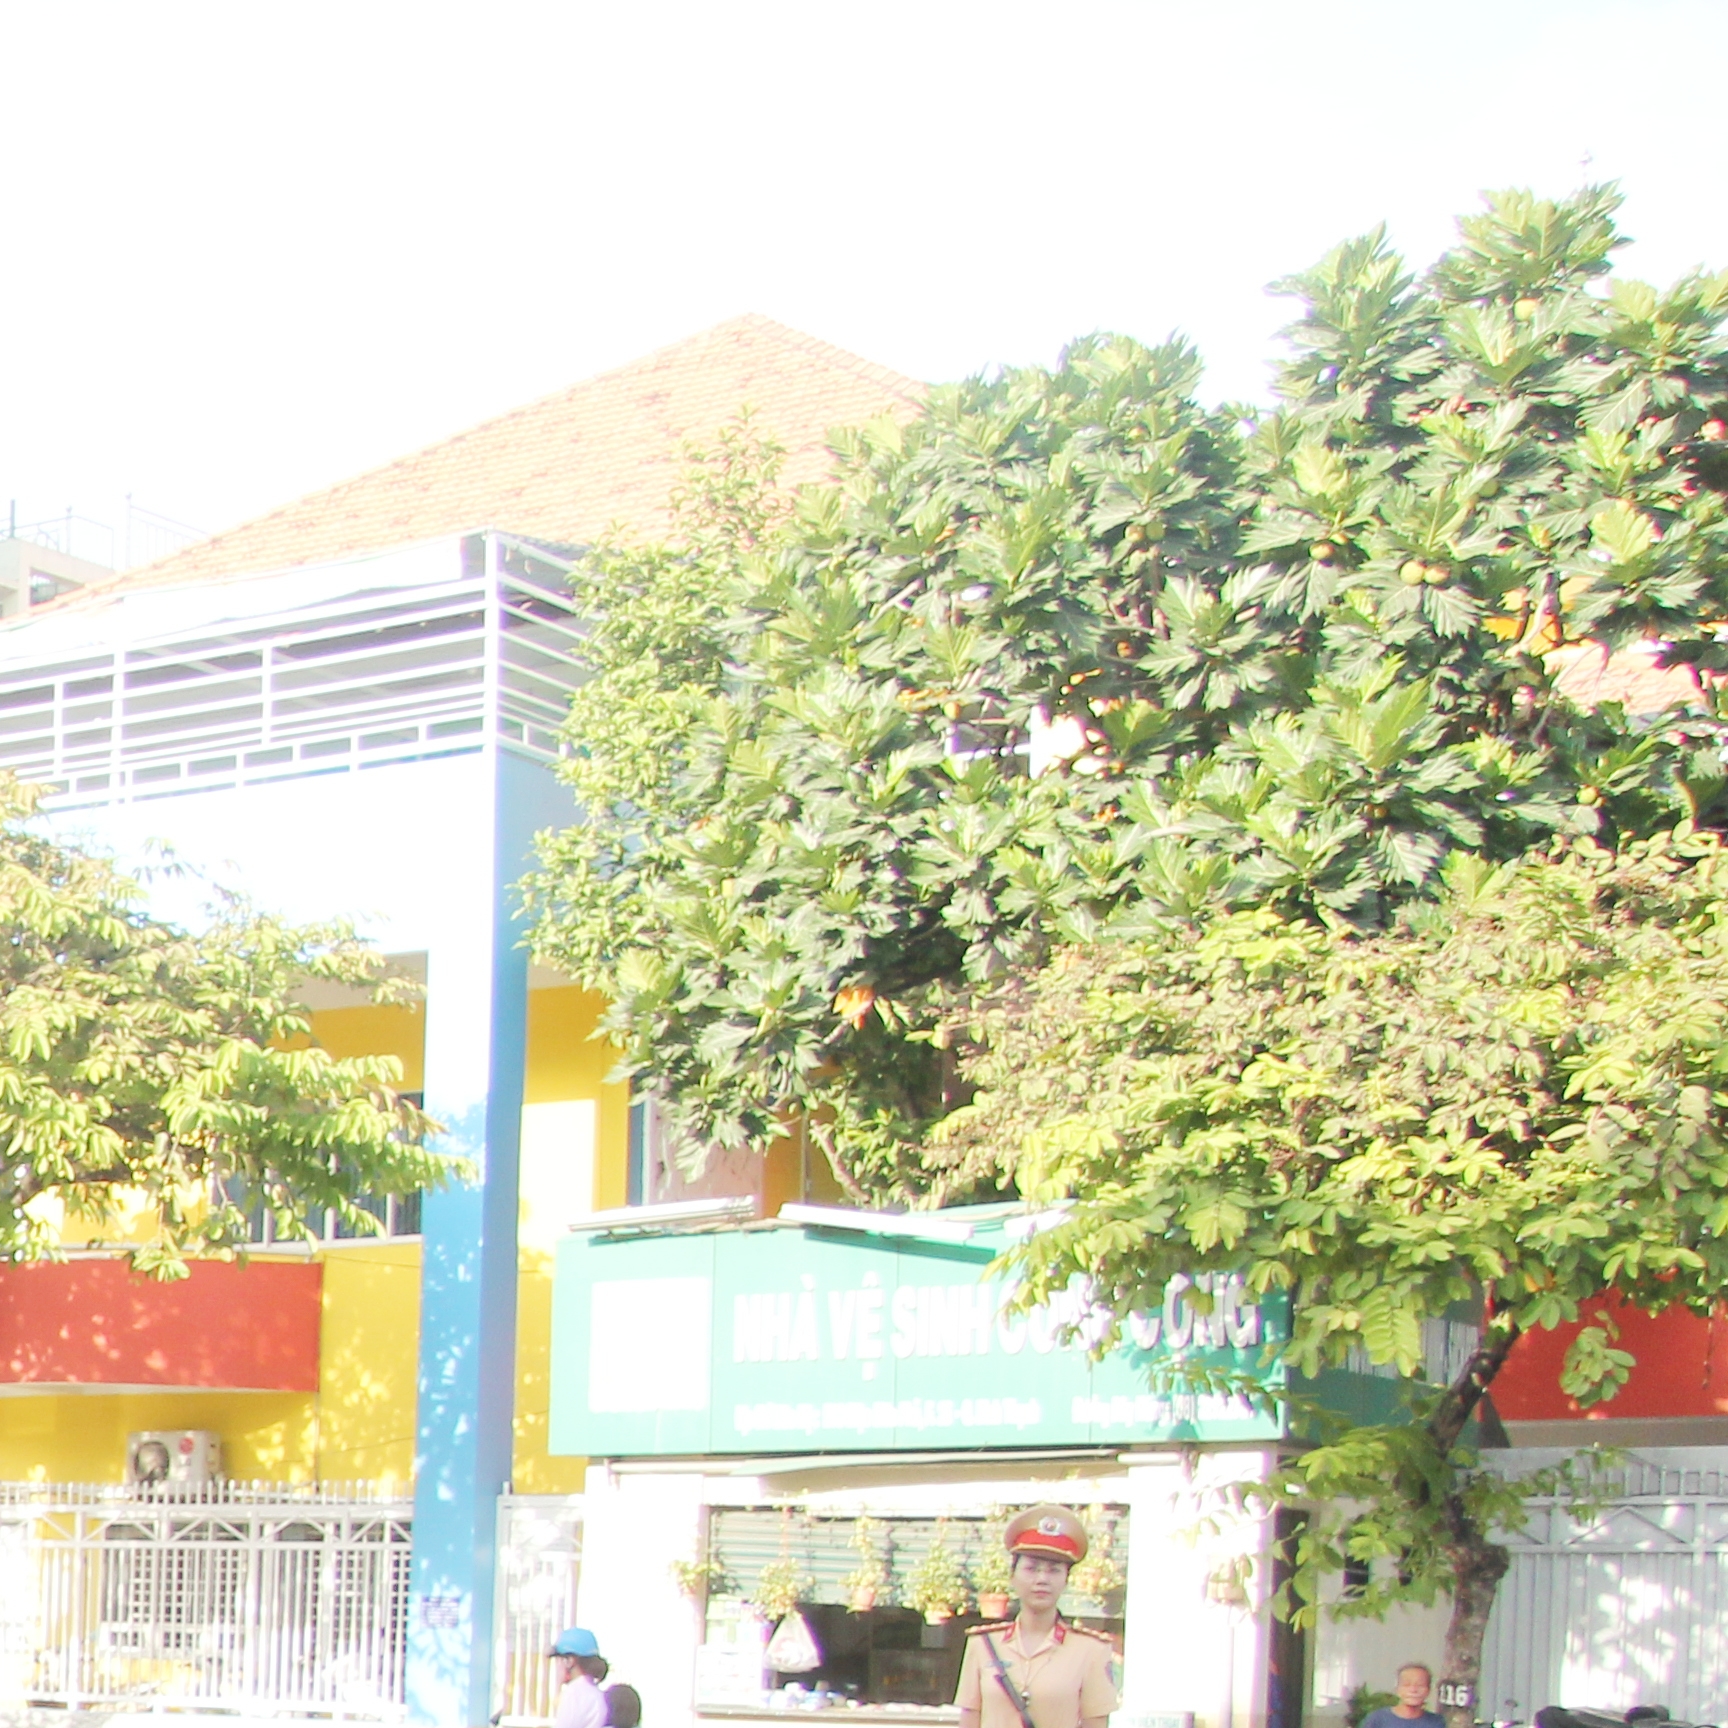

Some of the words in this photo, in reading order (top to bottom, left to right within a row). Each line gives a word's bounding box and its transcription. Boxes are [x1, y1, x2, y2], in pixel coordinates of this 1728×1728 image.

[732, 1274, 820, 1365] NHÀ
[827, 1271, 884, 1381] VỆ
[890, 1282, 992, 1358] SINH
[1439, 1684, 1469, 1707] 116
